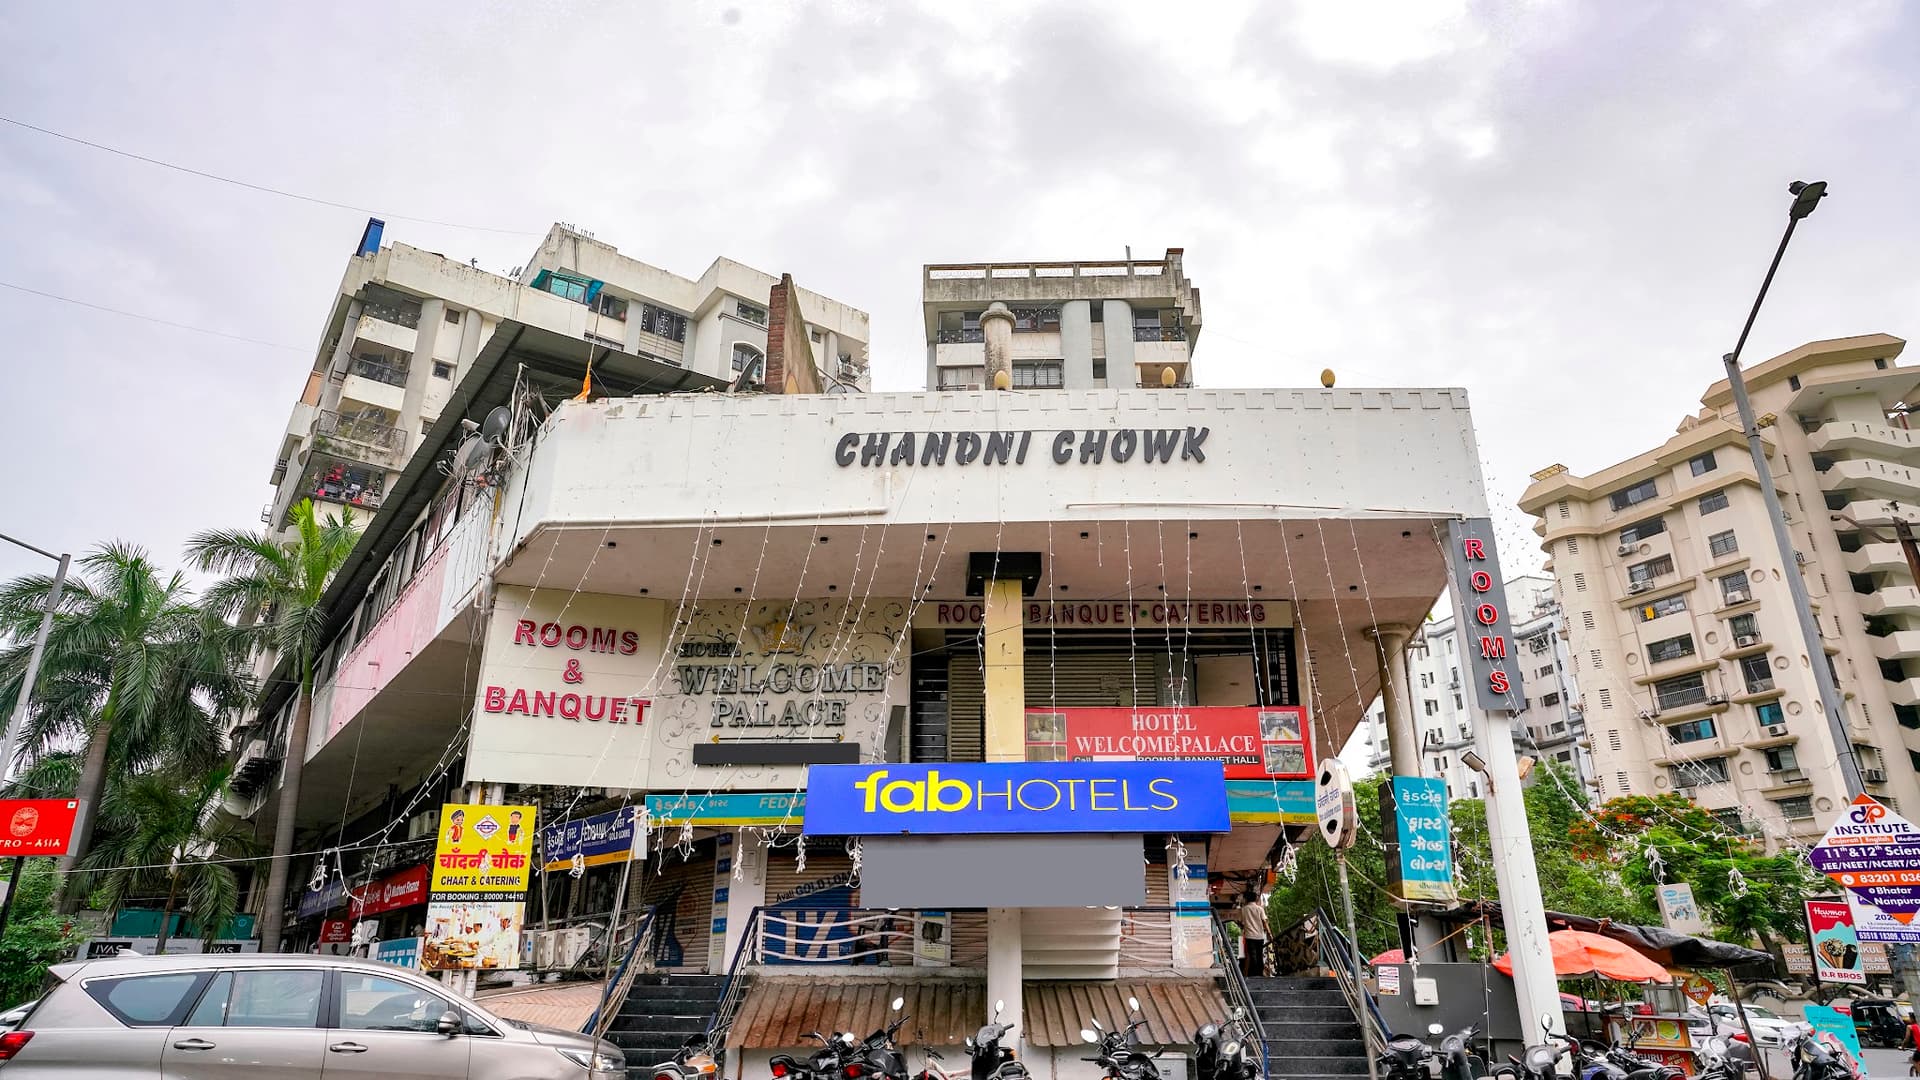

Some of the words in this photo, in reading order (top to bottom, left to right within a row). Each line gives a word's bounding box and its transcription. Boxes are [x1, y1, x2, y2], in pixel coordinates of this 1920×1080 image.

[835, 431, 1032, 466] CHANDNI
[1052, 426, 1210, 463] CHOWK
[938, 603, 984, 624] ROO
[1029, 603, 1139, 624] BANQUET
[1152, 603, 1266, 623] CATERING
[1464, 538, 1511, 694] ROOMS
[514, 619, 640, 656] ROOMS
[677, 642, 742, 658] HOTEL
[562, 658, 583, 684] &
[678, 663, 885, 696] WELCOME
[484, 686, 651, 726] BANQUET
[710, 699, 848, 728] PALACE
[1132, 713, 1197, 731] HOTEL
[1075, 736, 1176, 753] WELCOME
[1181, 735, 1256, 753] PALACE
[1232, 756, 1258, 764] HALL
[1834, 823, 1910, 835] INSTITUTE
[34, 838, 61, 848] ASIA
[1822, 859, 1920, 871] JEE/NEET/NCERT/G
[440, 876, 469, 886] CHAAT
[471, 876, 477, 885] &
[479, 875, 520, 886] CATERING
[1859, 873, 1896, 884] 83201
[1812, 906, 1848, 917] Havmor
[1837, 972, 1863, 980] BROS
